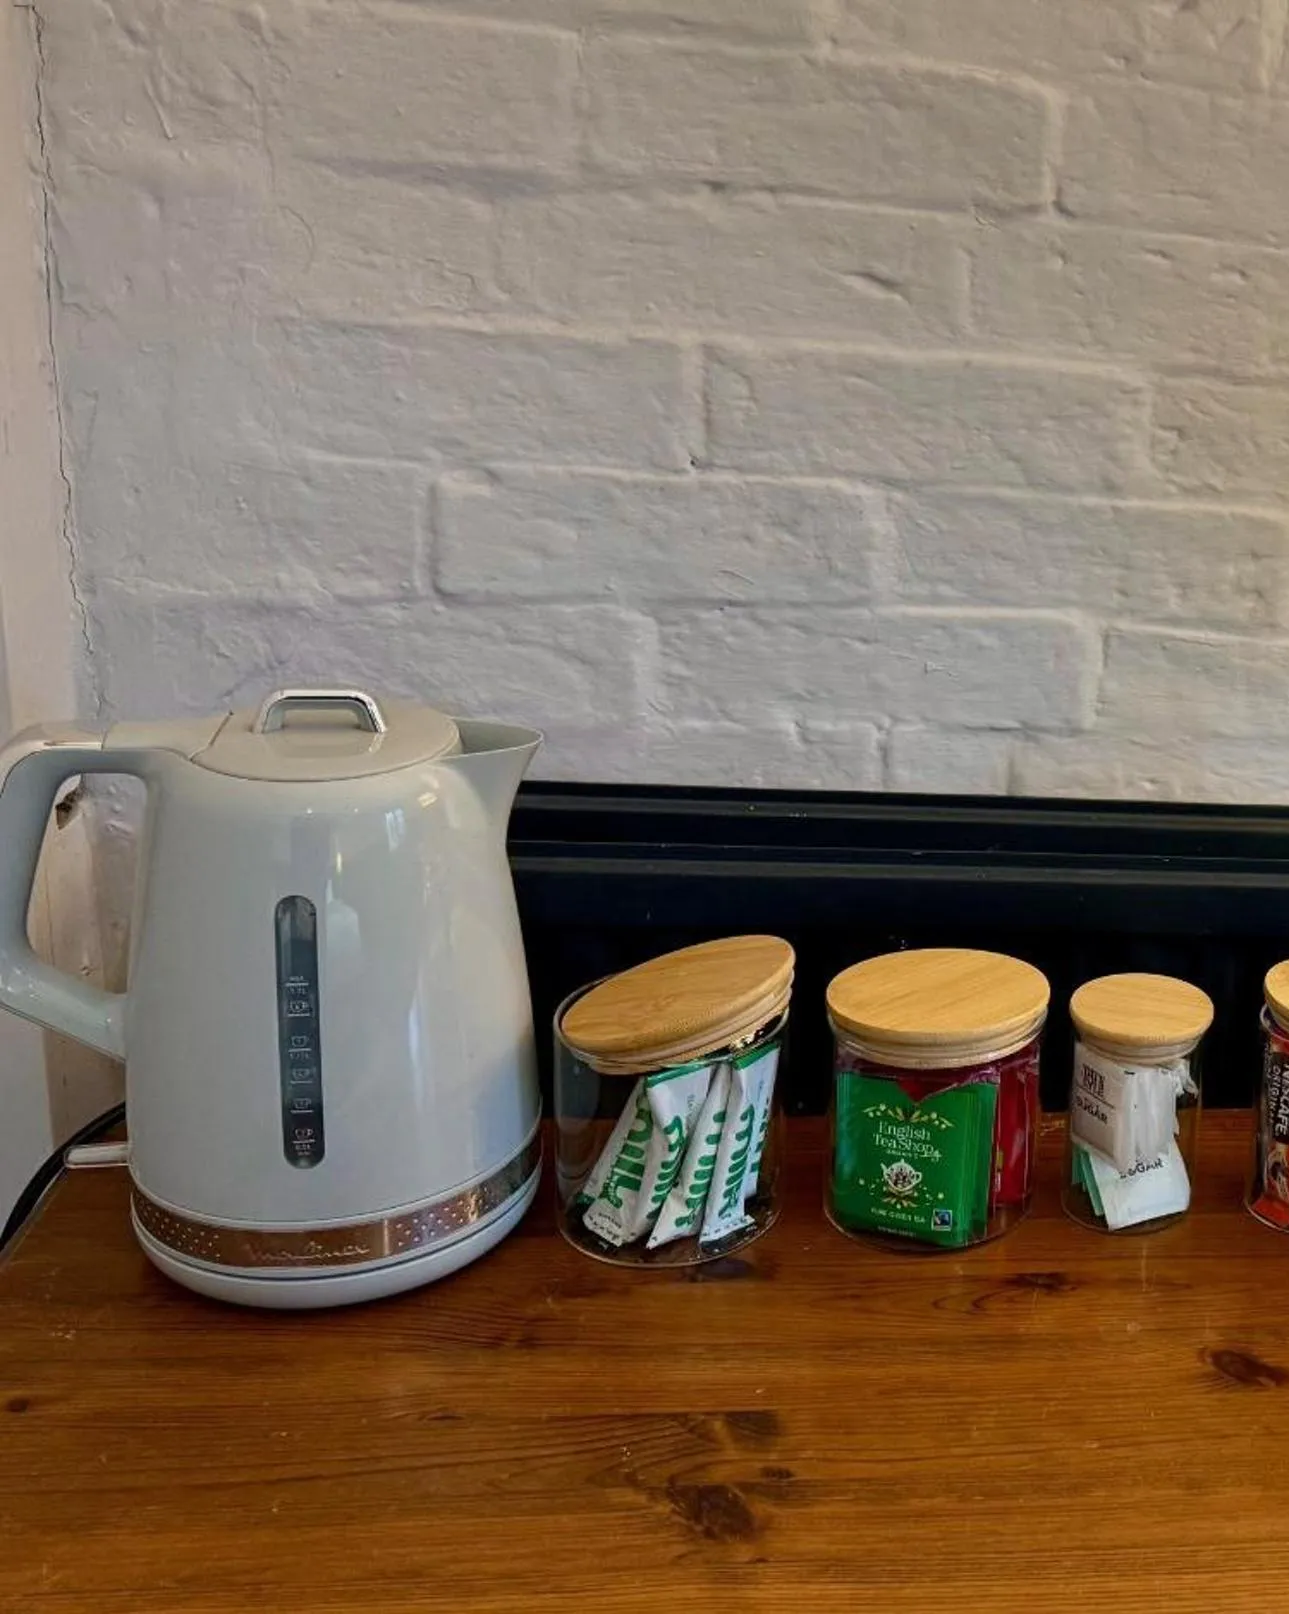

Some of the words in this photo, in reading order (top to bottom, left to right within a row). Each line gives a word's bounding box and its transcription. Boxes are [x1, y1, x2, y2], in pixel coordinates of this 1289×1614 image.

[879, 1121, 931, 1141] English
[873, 1133, 897, 1149] Tea
[899, 1139, 934, 1158] Shop
